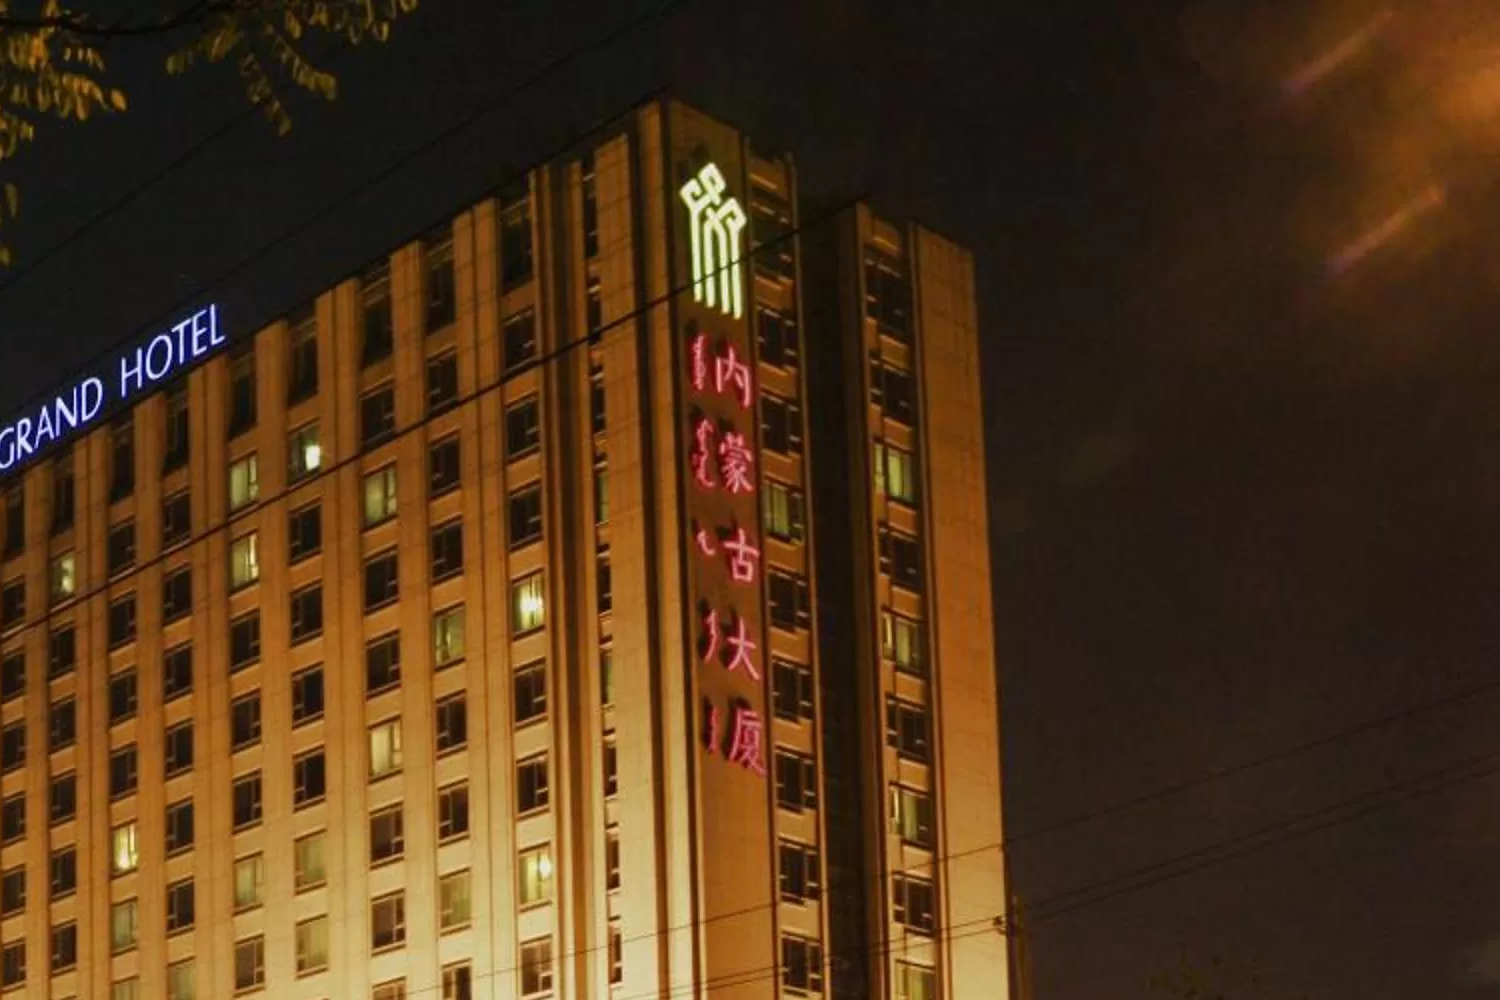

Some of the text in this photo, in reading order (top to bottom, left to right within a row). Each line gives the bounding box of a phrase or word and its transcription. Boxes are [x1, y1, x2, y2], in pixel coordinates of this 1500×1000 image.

[120, 303, 227, 399] HOTEL
[715, 344, 767, 778] 内蒙古大厦
